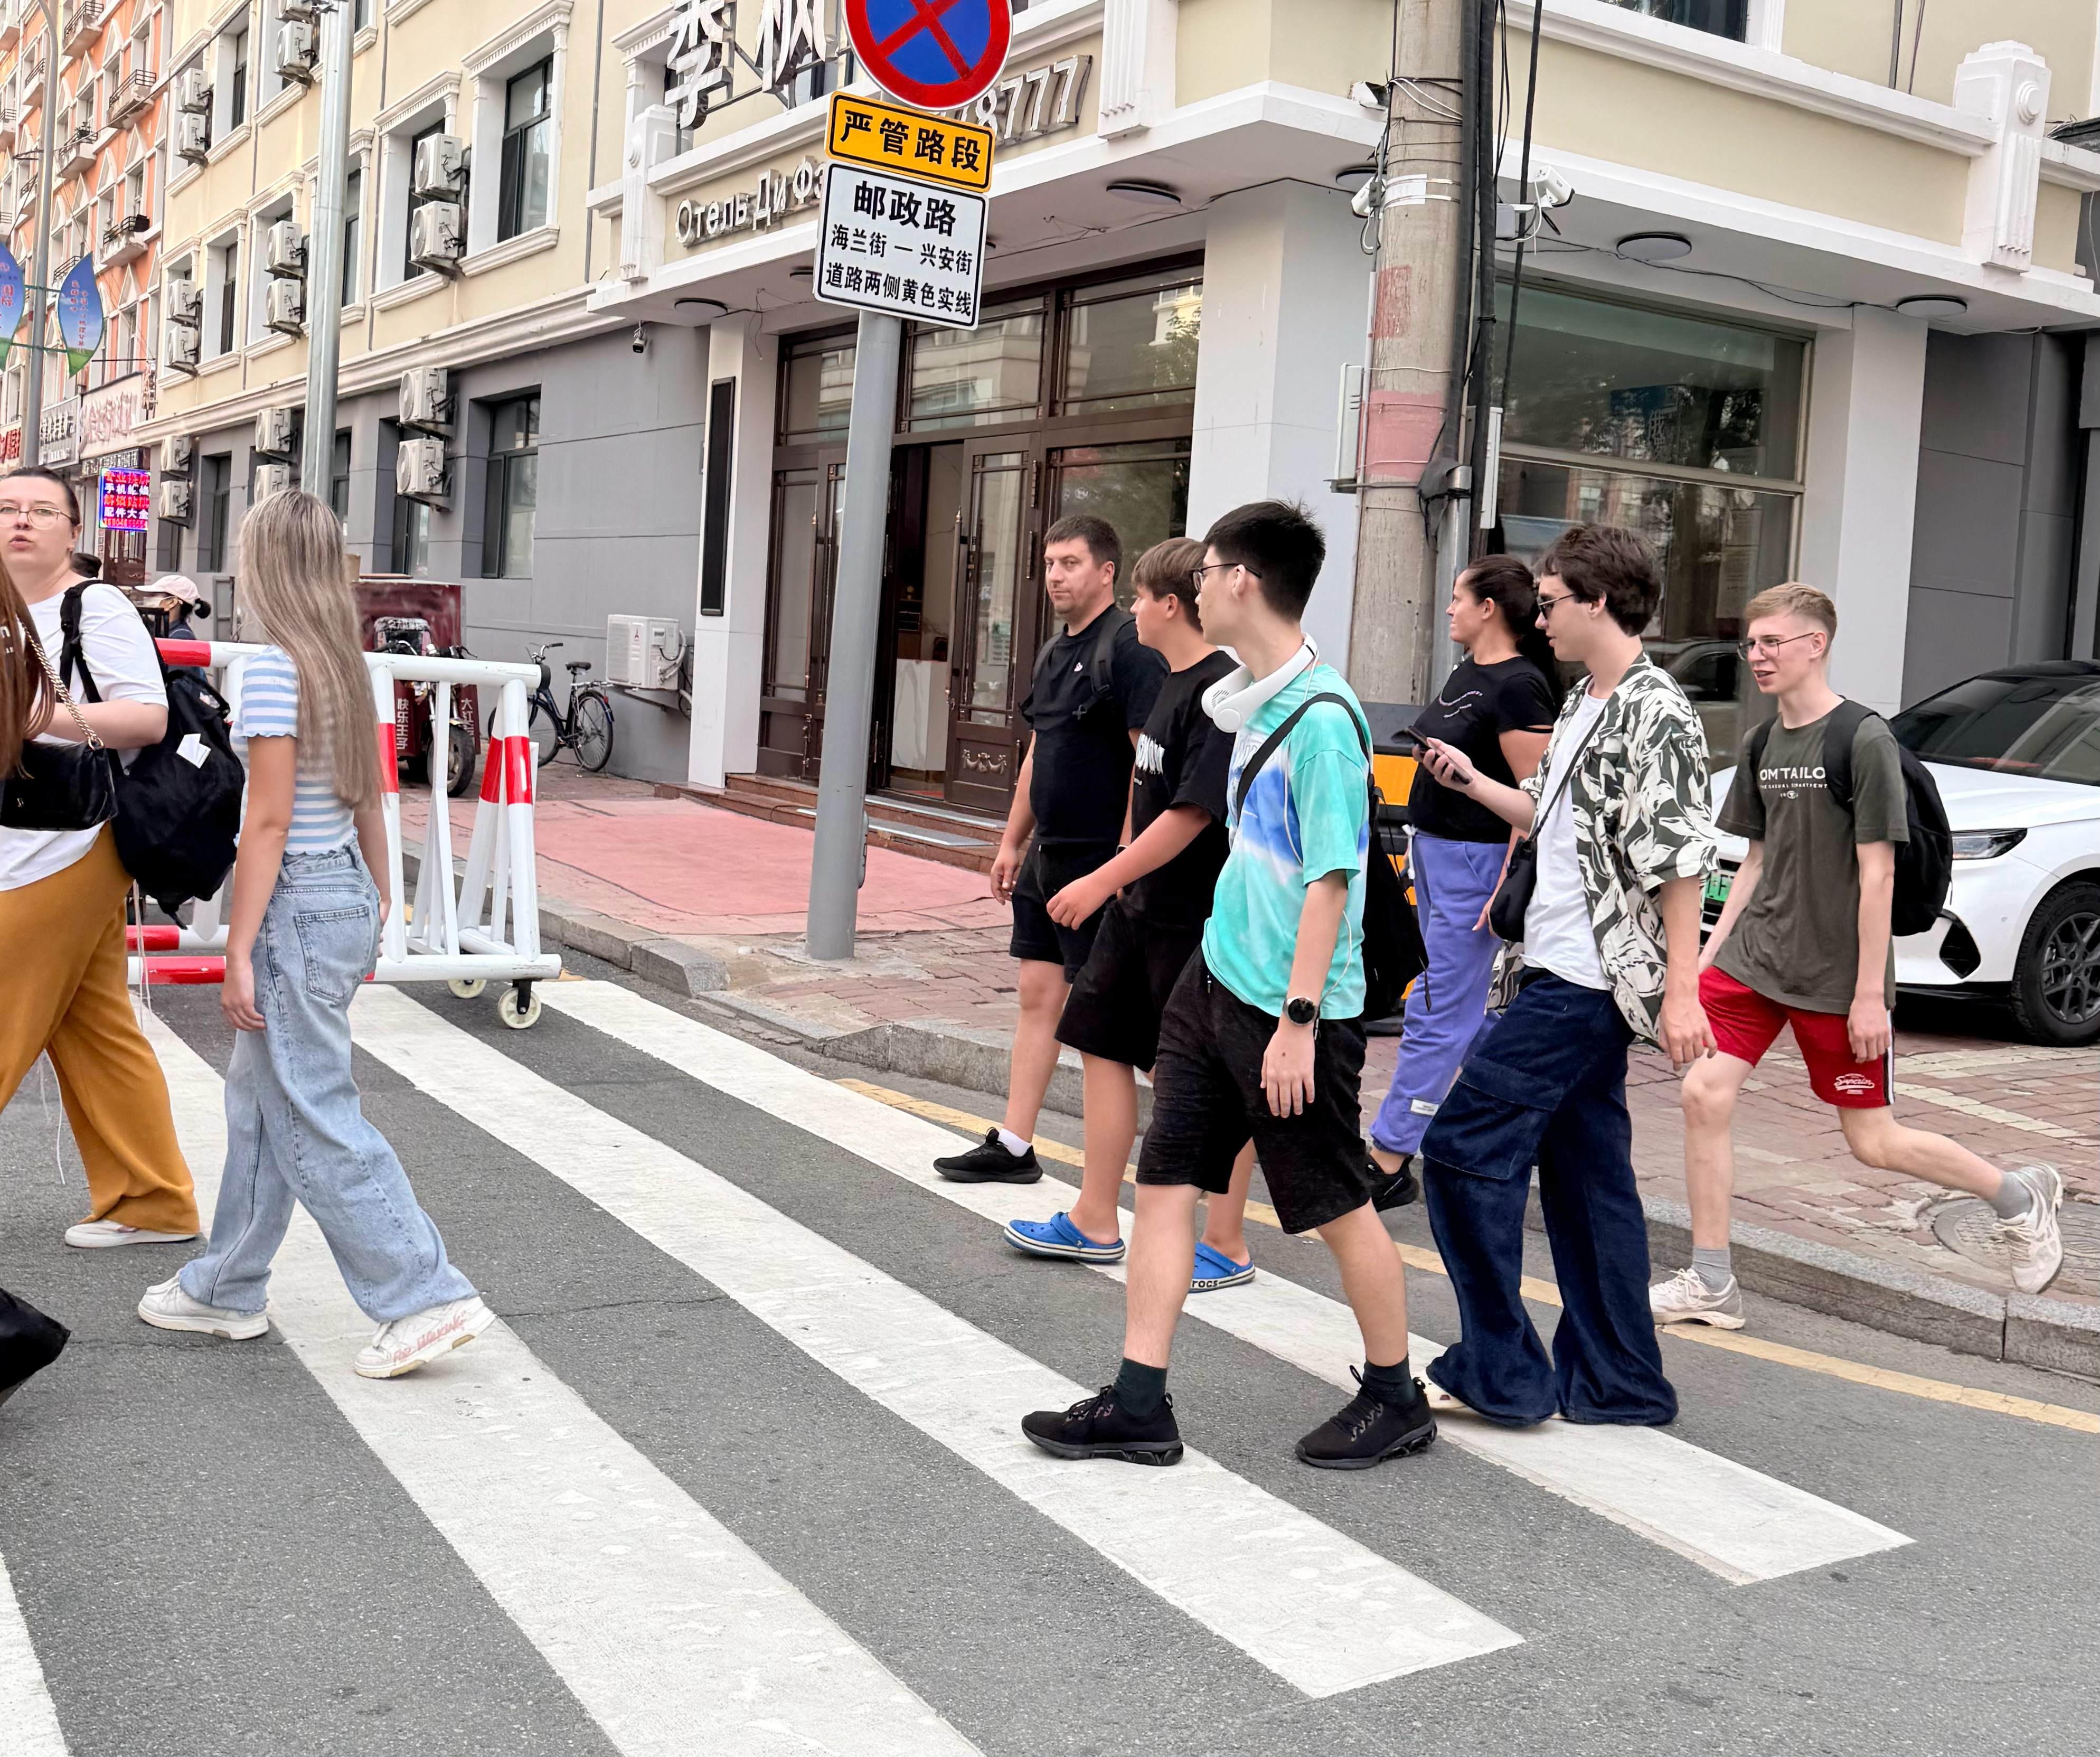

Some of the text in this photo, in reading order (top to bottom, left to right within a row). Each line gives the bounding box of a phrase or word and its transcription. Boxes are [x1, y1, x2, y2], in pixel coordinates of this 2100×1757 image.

[962, 55, 1089, 140] 8777
[840, 109, 981, 173] 严管路段
[675, 155, 824, 243] Отель Ди Фэ
[853, 180, 957, 238] 邮政路
[825, 261, 972, 317] 道路两侧黄色实线
[397, 698, 409, 750] 快乐王子
[1759, 766, 1826, 781] OM TAILO
[1192, 1280, 1218, 1288] rocs
